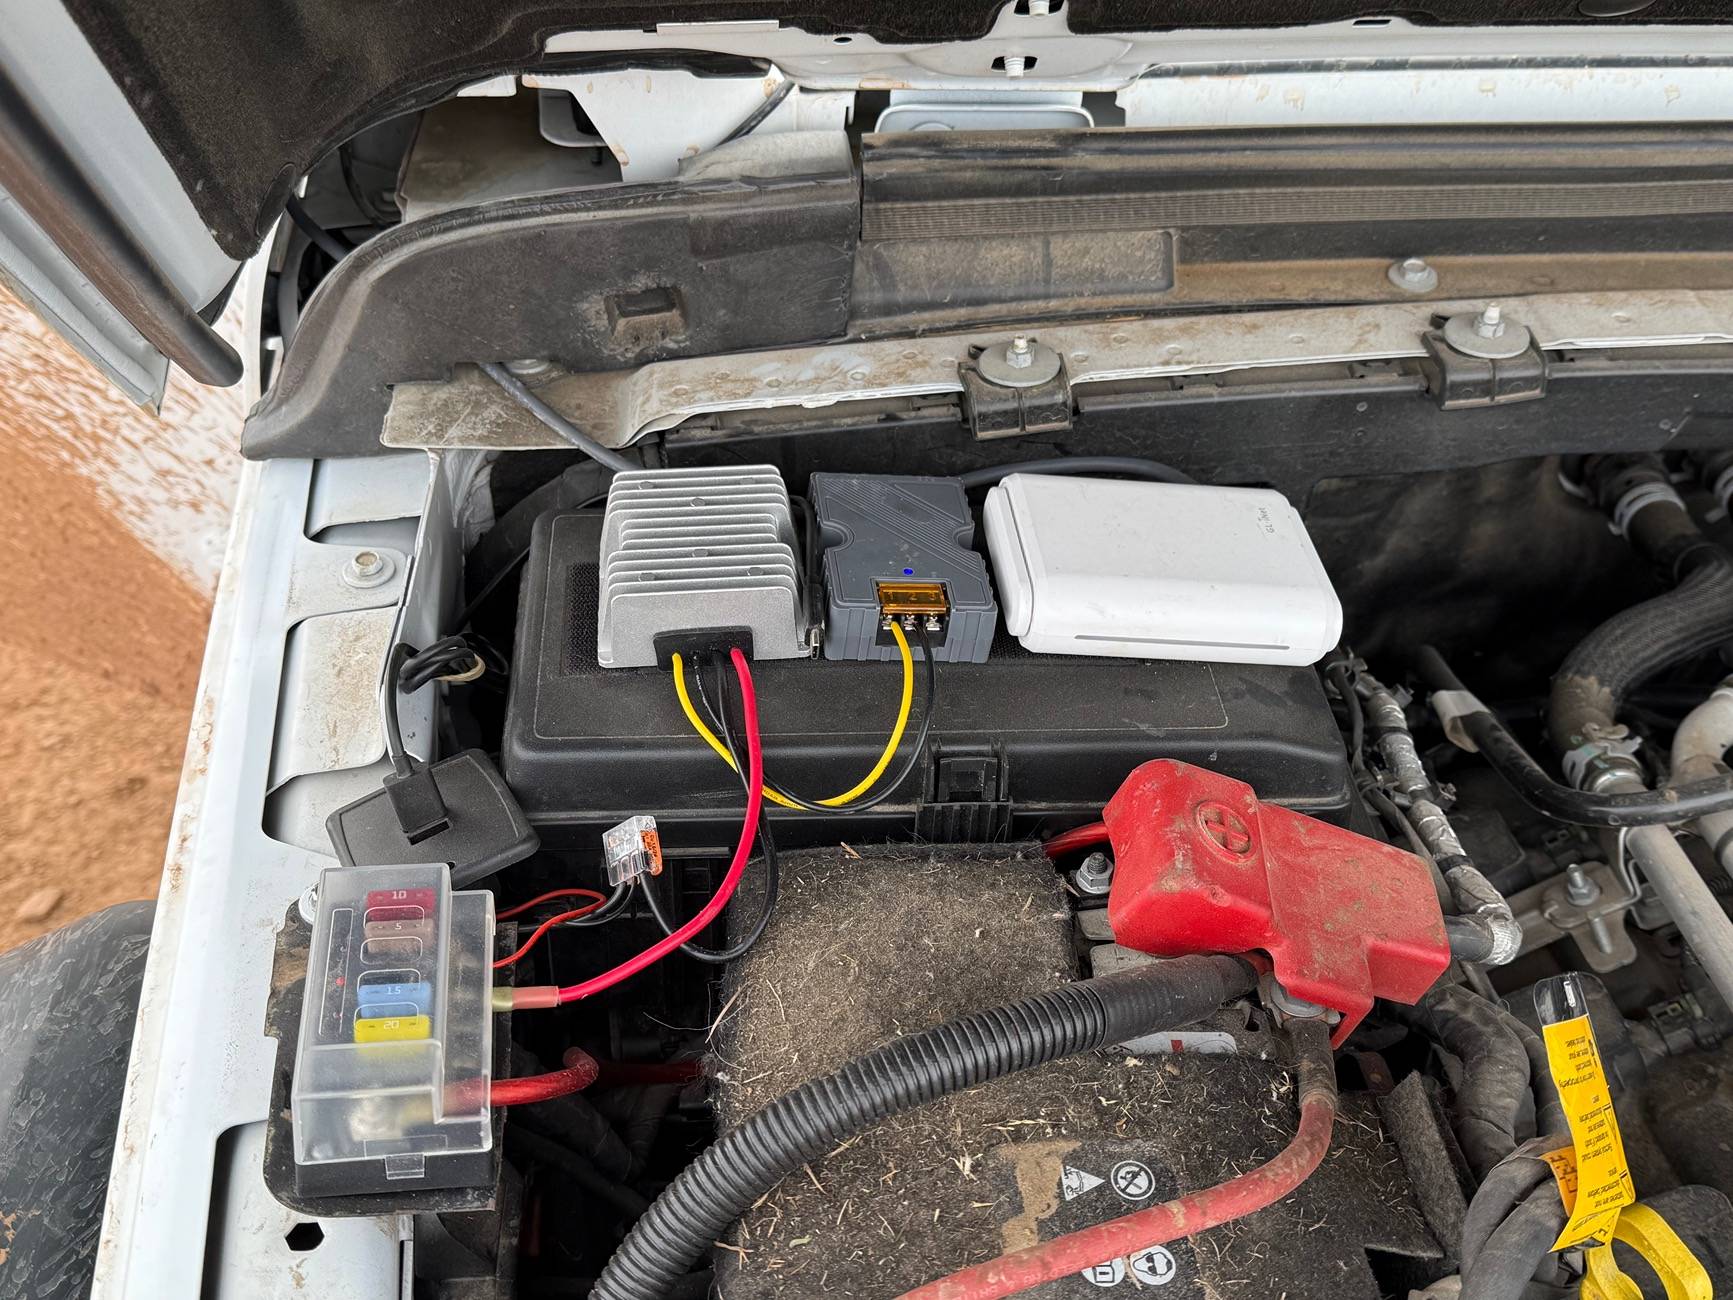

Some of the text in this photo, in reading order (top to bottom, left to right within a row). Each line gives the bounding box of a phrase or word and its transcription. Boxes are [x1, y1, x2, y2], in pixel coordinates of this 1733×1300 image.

[391, 890, 407, 900] 10
[394, 922, 402, 930] 5
[386, 986, 401, 995] 15
[384, 1020, 400, 1029] 20
